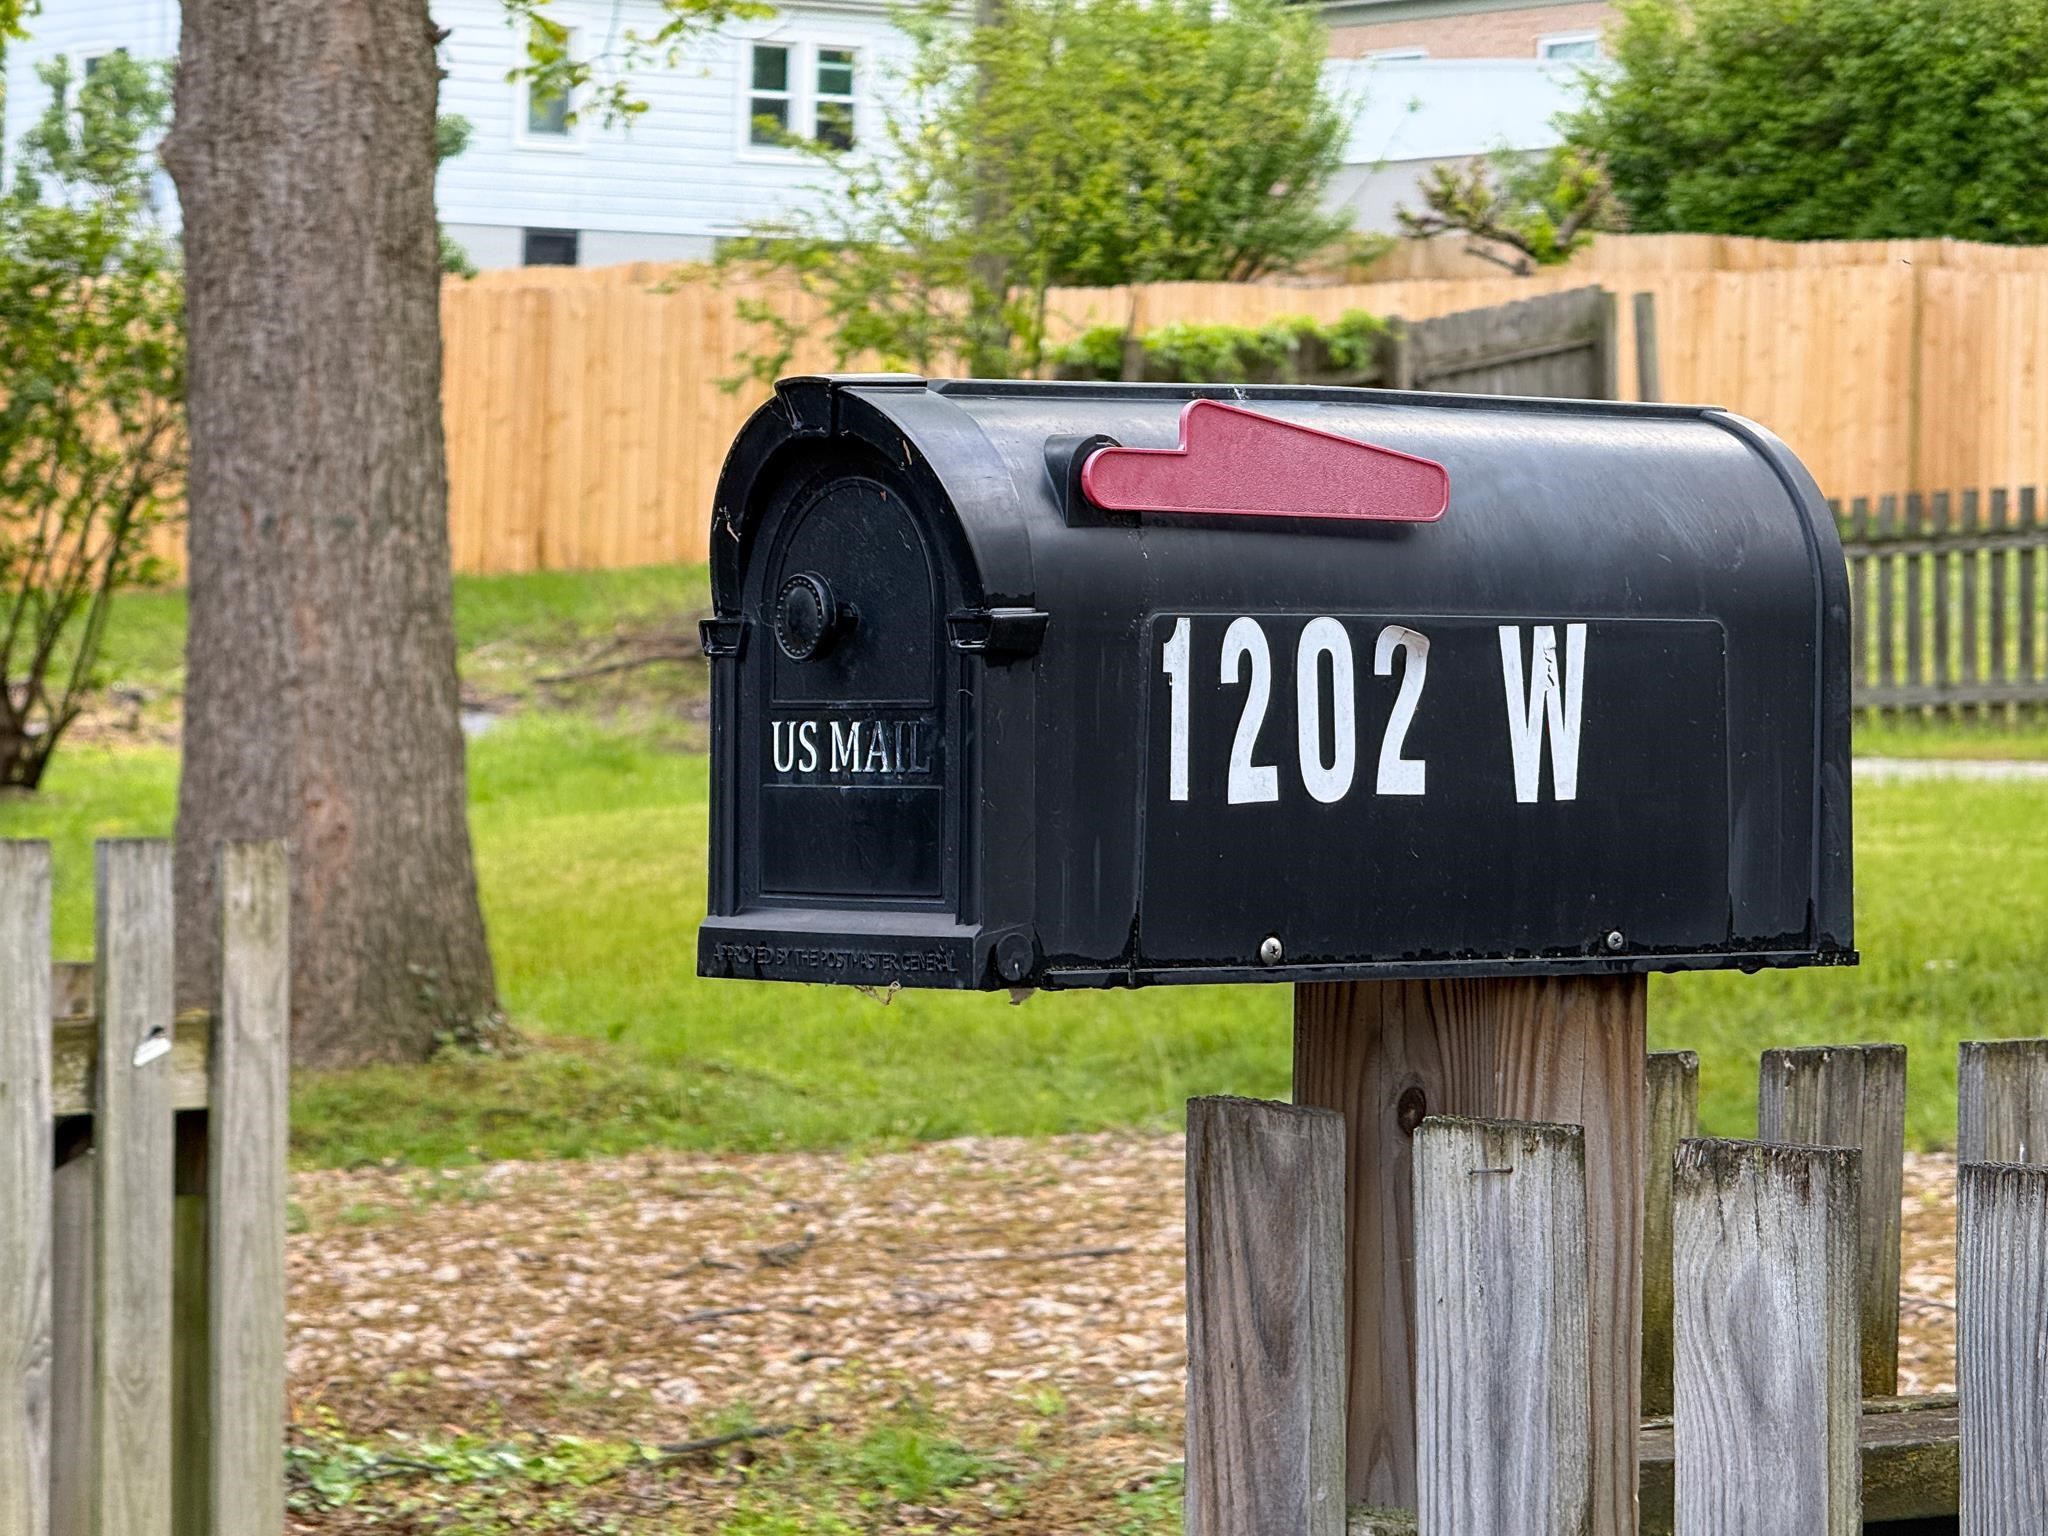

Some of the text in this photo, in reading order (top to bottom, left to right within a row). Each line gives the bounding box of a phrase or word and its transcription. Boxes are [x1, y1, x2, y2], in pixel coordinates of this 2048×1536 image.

[1162, 616, 1588, 805] 1202 W
[771, 720, 931, 773] US MAIL
[793, 948, 819, 967] THE
[901, 952, 959, 972] GENERAL
